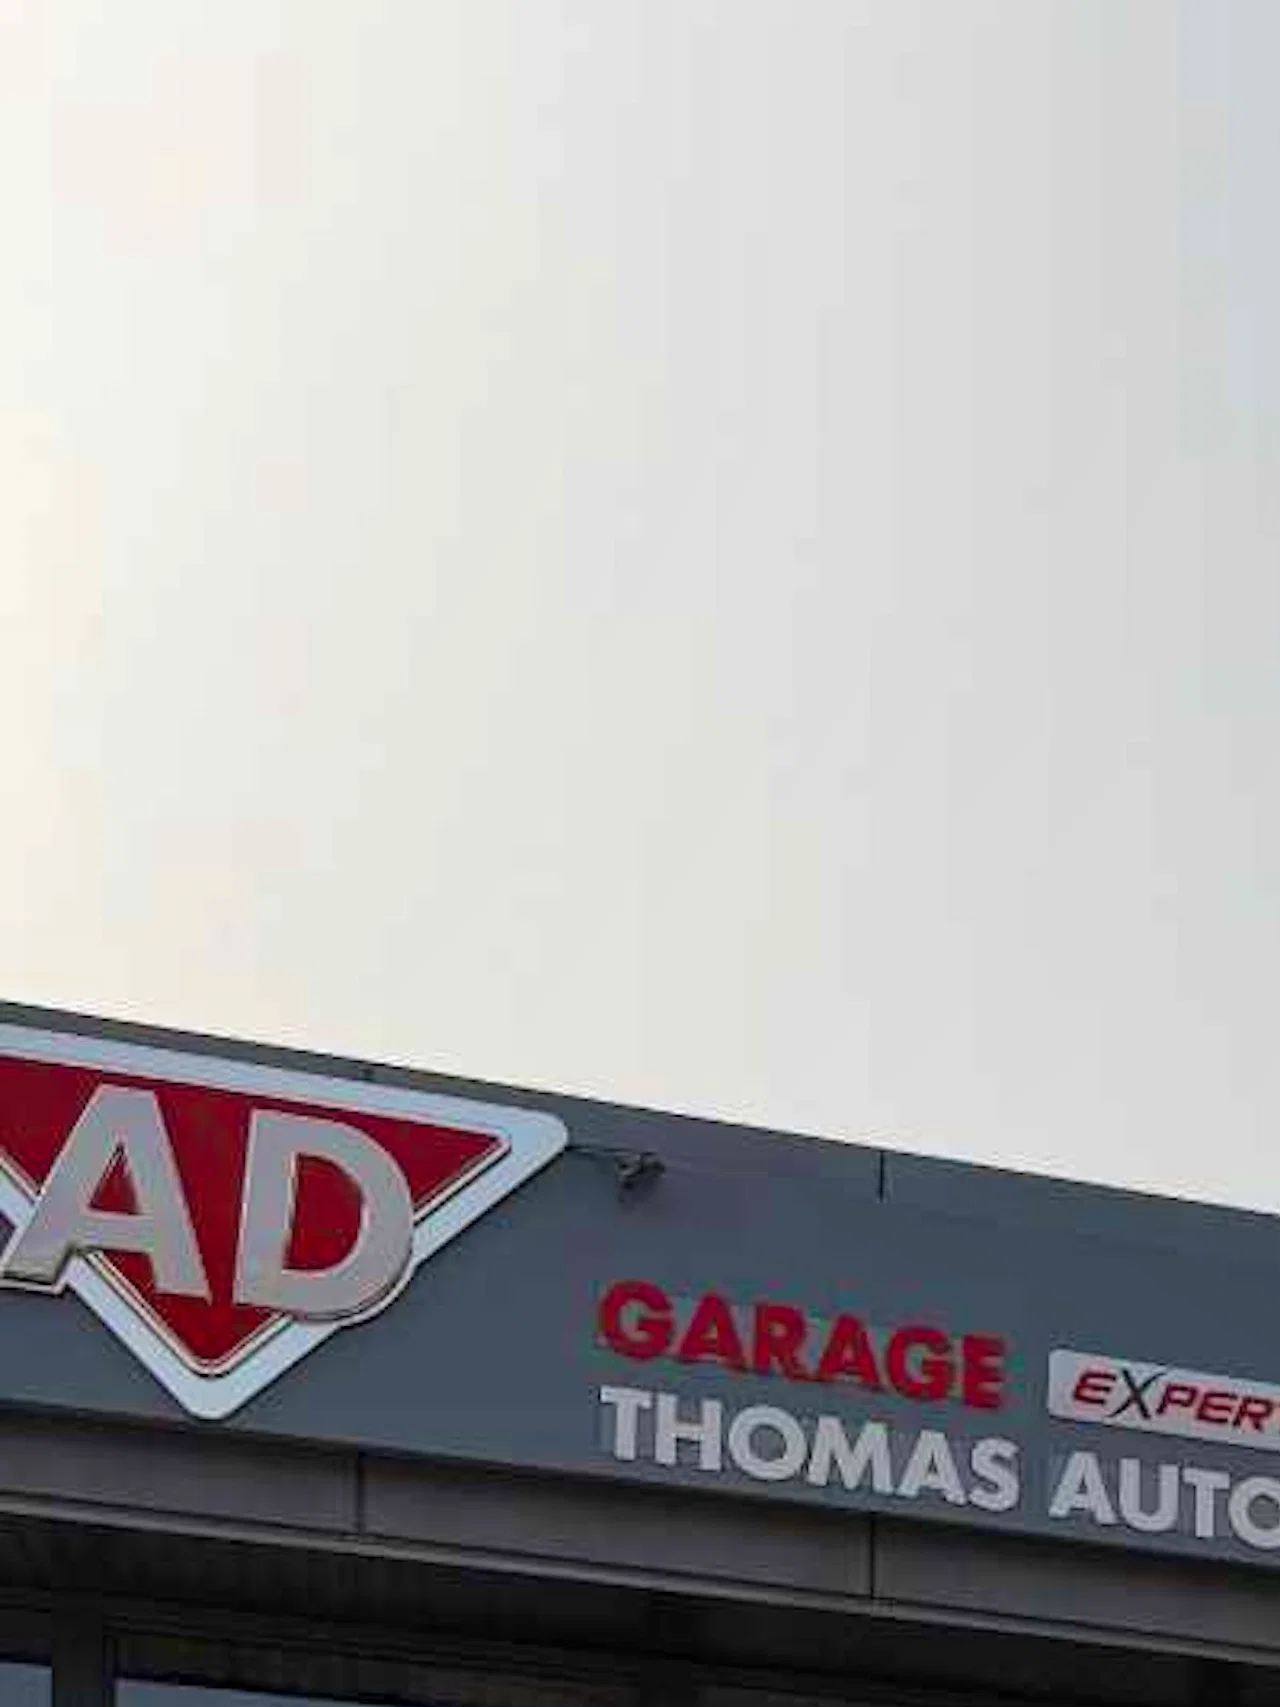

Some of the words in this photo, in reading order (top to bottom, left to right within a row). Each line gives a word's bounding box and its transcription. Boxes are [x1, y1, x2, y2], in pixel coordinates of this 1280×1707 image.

[3, 1083, 415, 1322] AD
[599, 1280, 1006, 1408] GARAGE
[600, 1384, 1019, 1513] THOMAS
